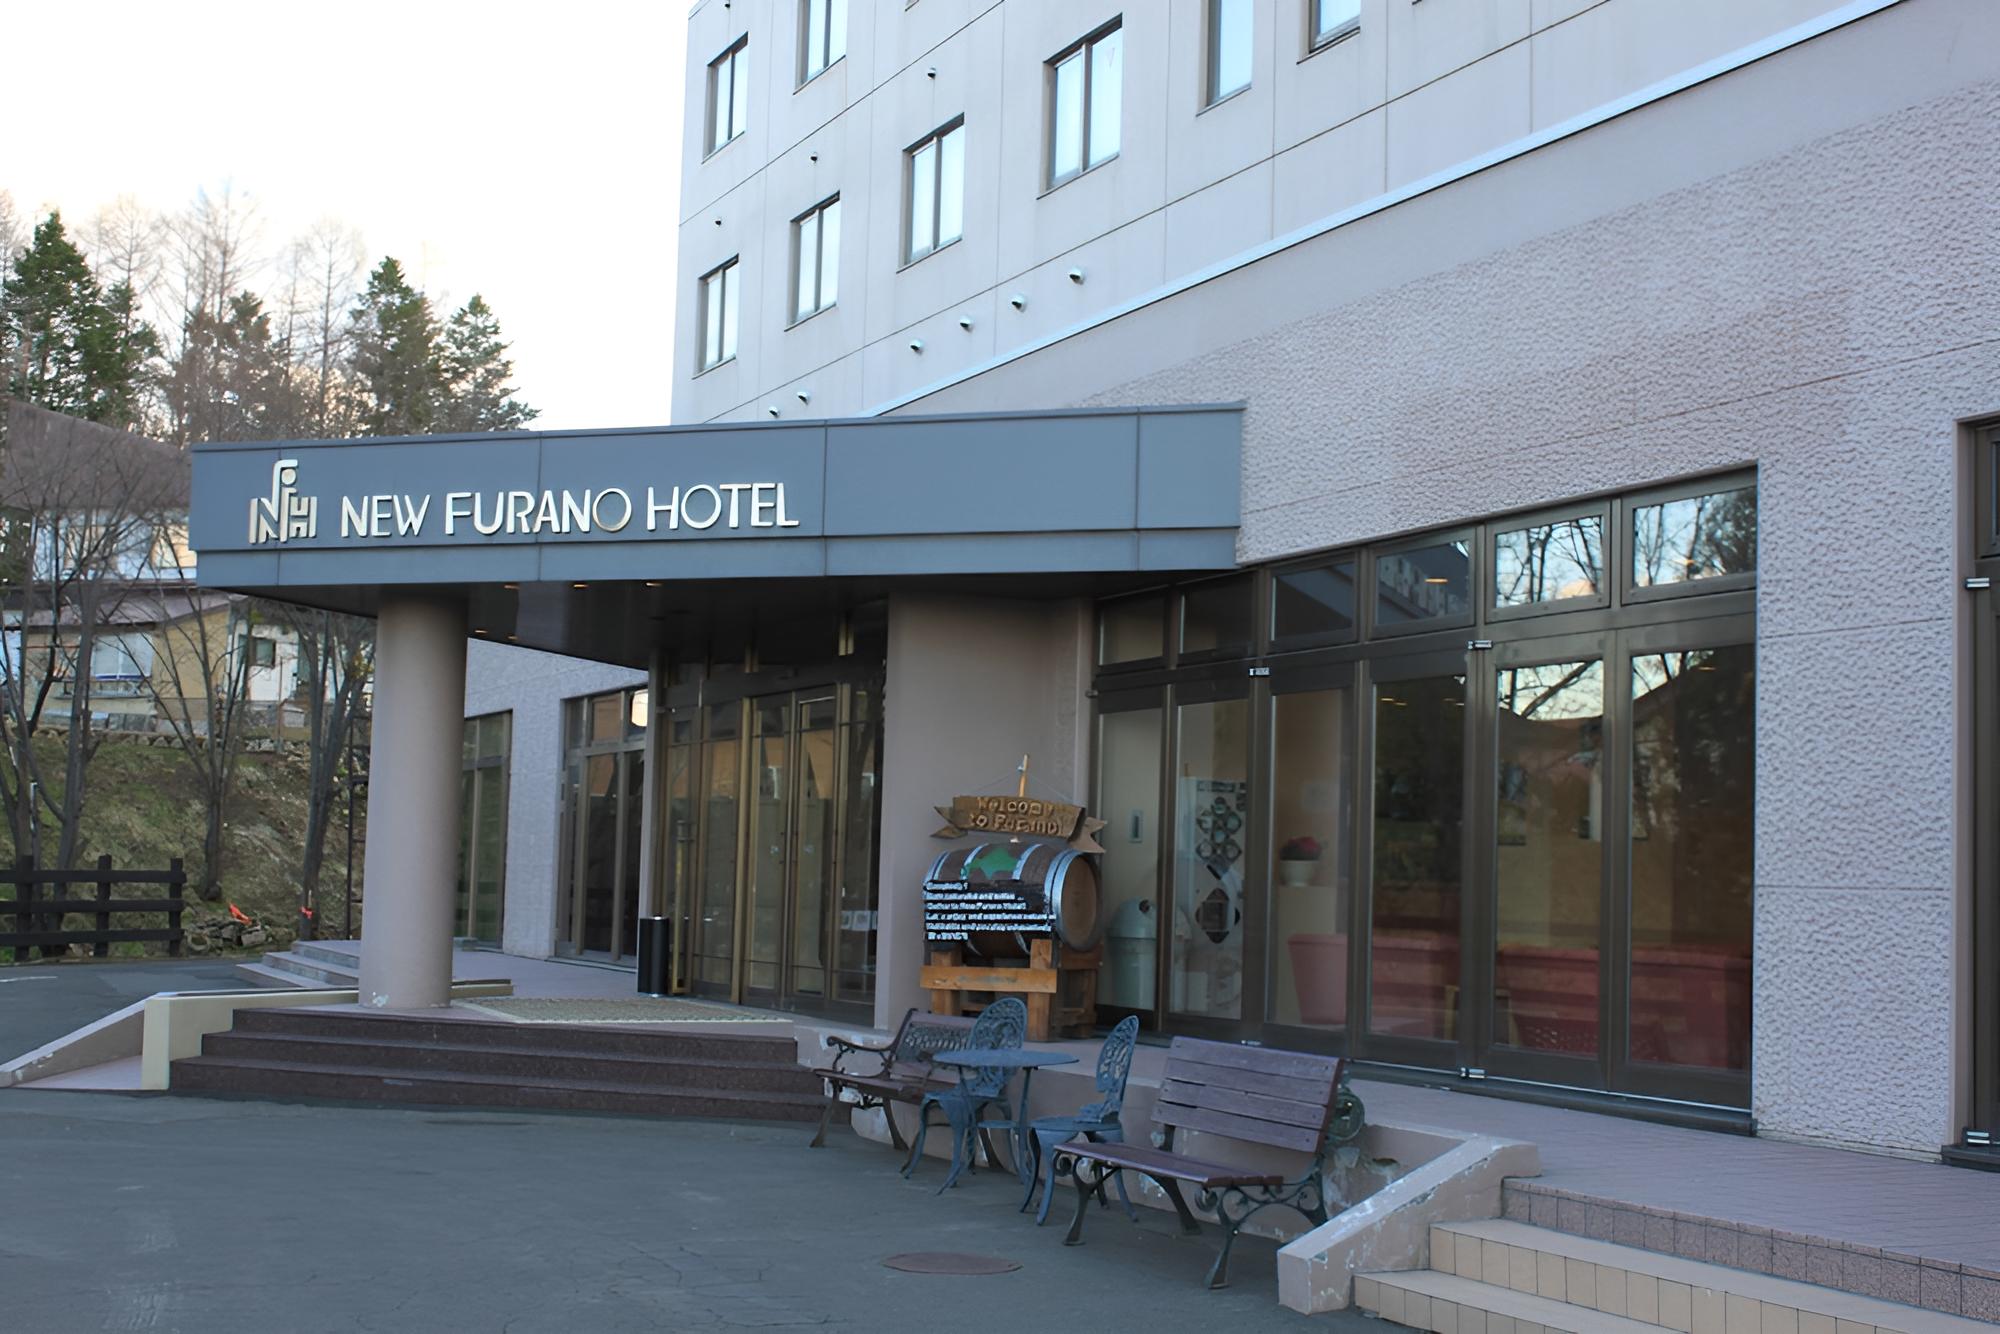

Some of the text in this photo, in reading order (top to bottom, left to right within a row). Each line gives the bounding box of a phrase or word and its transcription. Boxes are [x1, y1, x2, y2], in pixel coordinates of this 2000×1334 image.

[341, 482, 799, 537] NEW FURANO HOTEL
